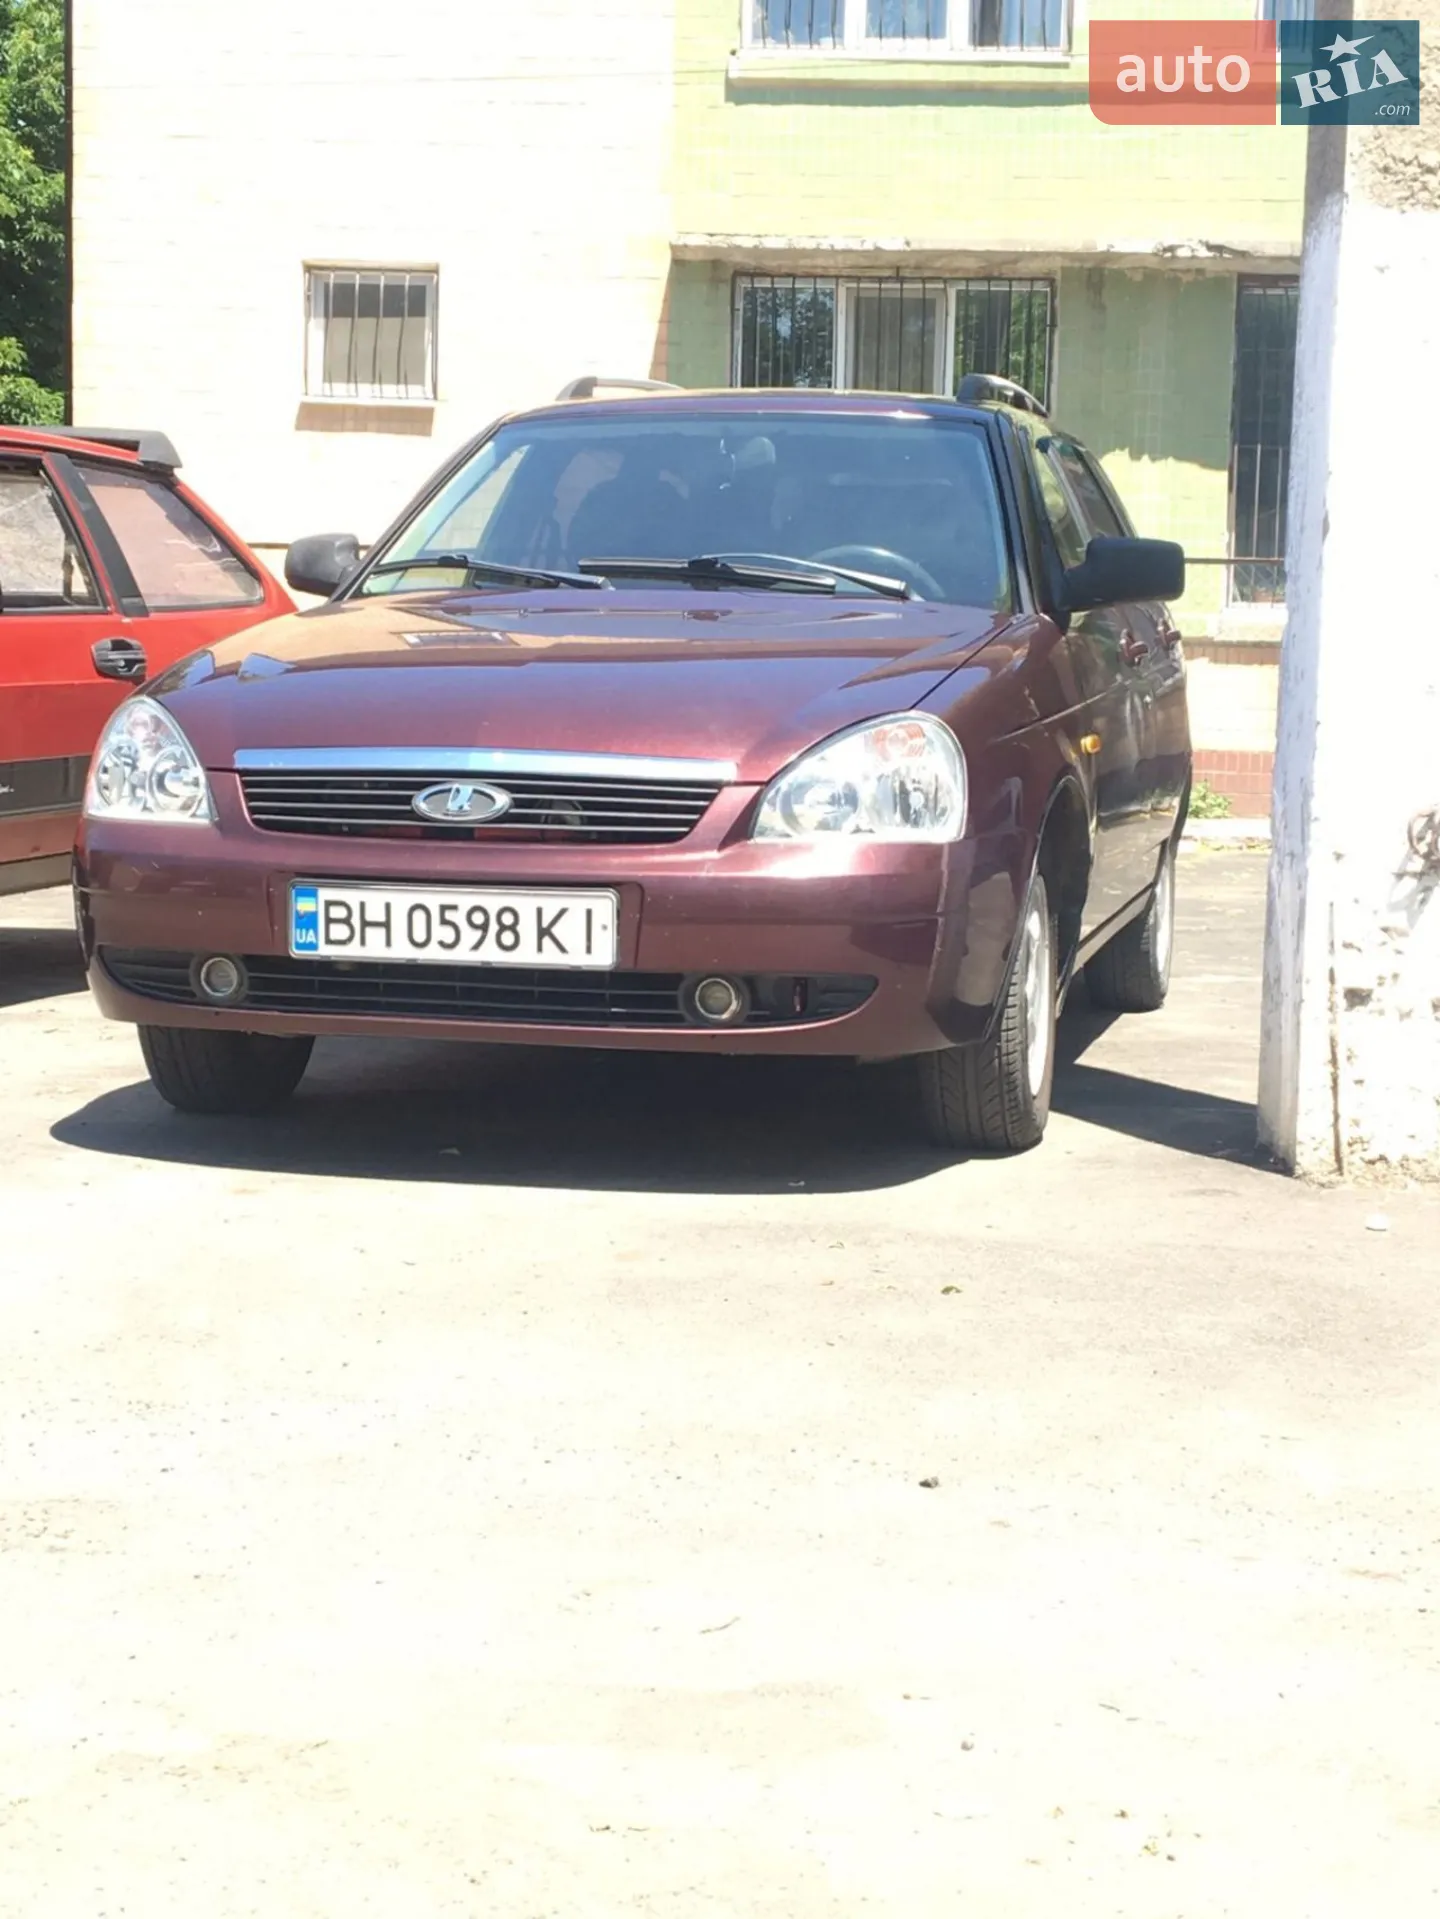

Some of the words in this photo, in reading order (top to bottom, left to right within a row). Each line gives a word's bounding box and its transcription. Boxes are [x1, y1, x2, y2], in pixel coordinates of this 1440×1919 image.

[295, 927, 318, 945] UA
[323, 899, 392, 948] BH
[406, 902, 521, 953] 0598
[535, 905, 593, 955] KI
